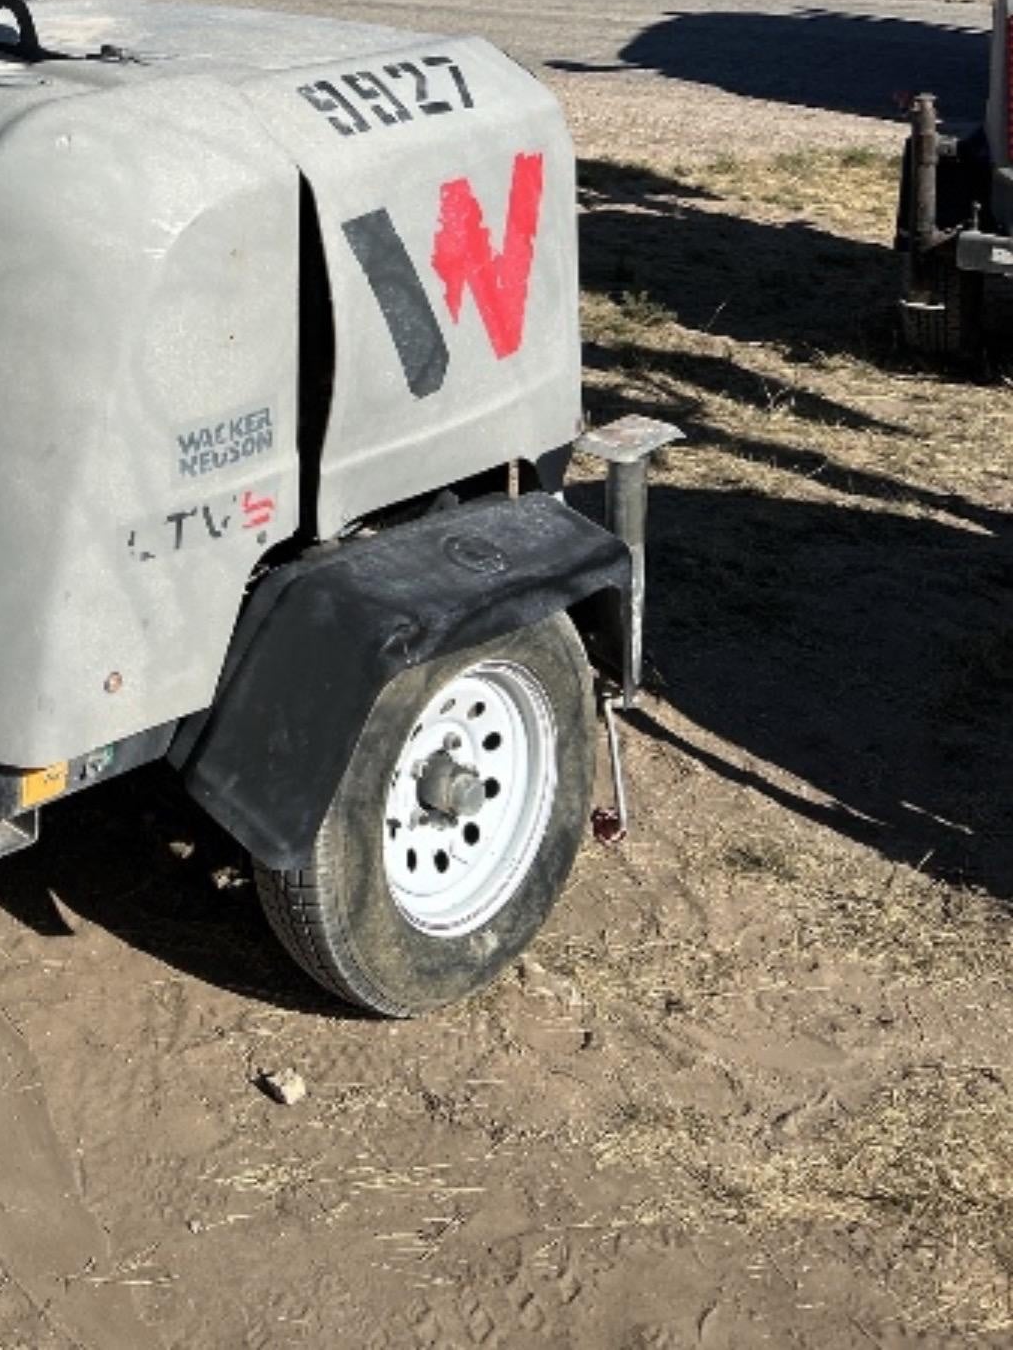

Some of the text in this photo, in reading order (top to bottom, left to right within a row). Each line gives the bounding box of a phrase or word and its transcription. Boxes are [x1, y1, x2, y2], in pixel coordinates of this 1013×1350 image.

[297, 56, 474, 136] 9927
[177, 407, 273, 453] WACKER
[179, 429, 274, 478] NEUSON
